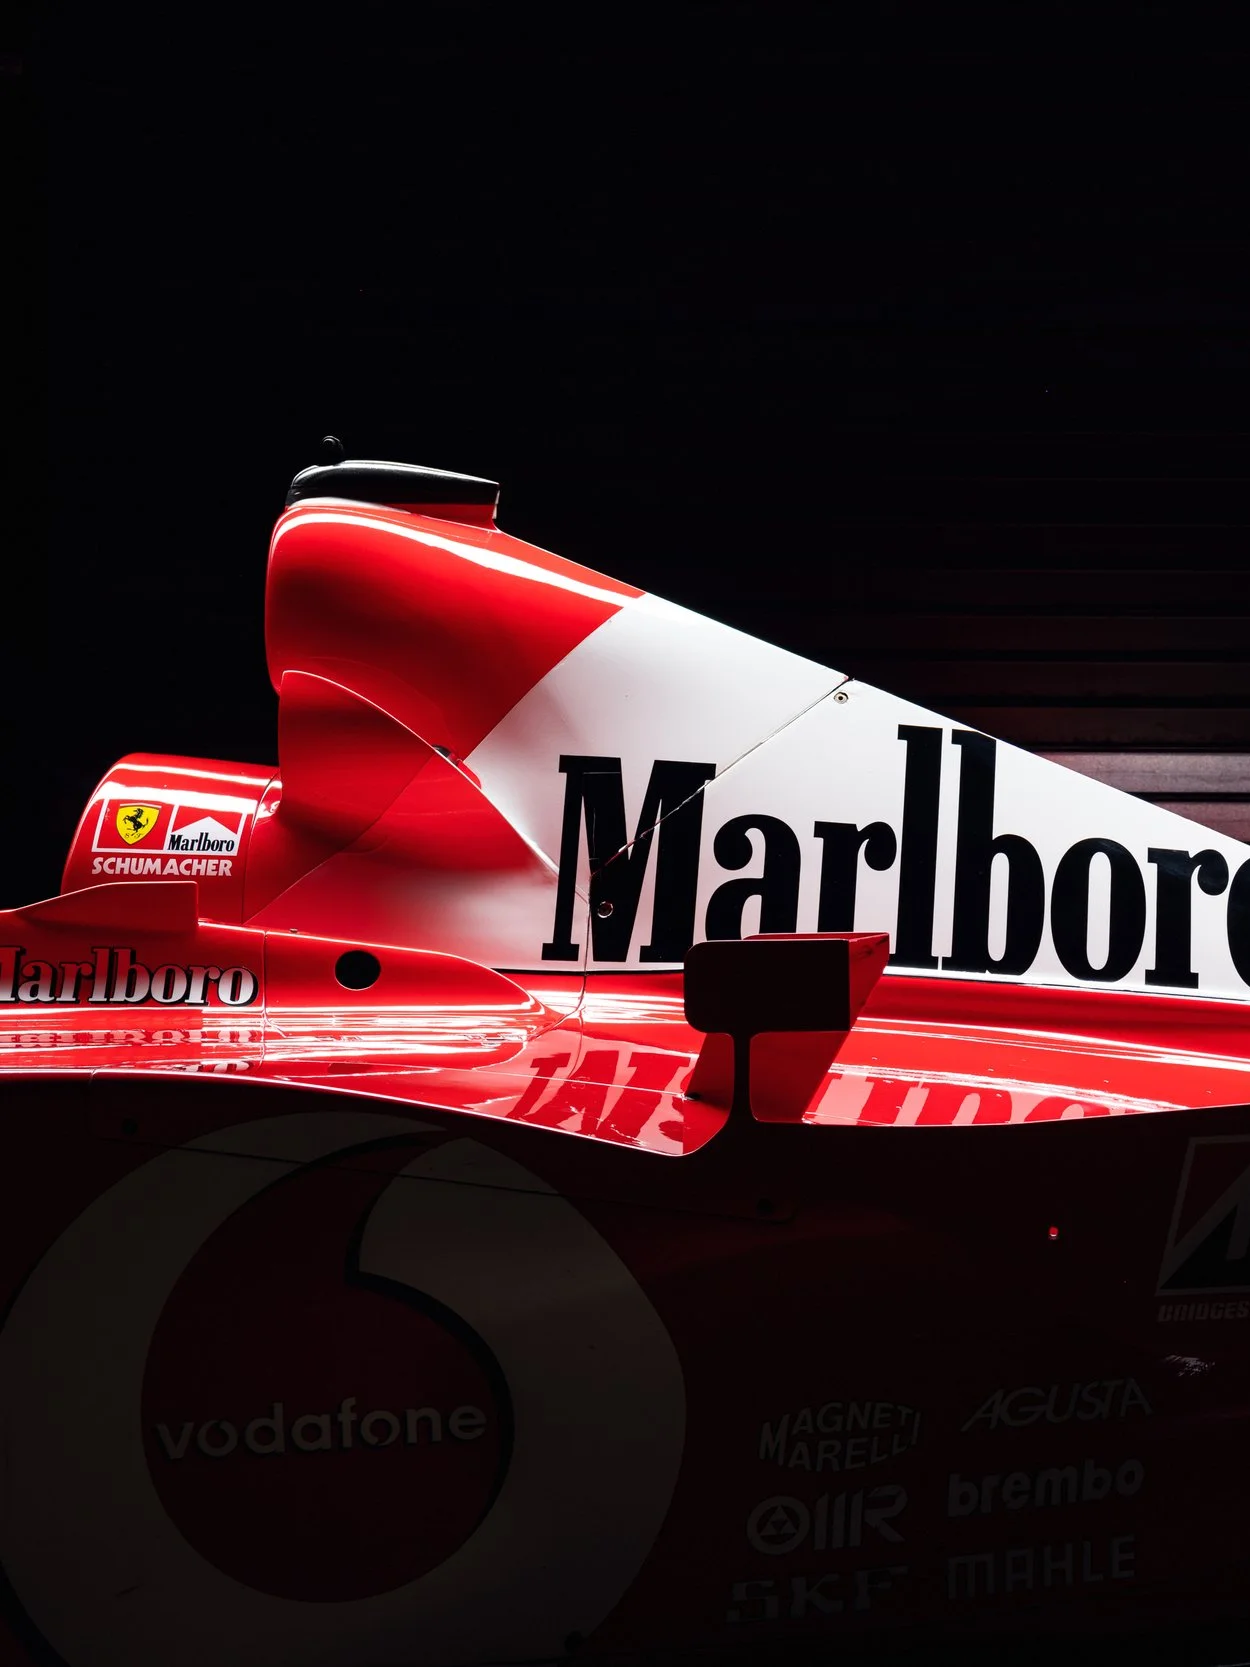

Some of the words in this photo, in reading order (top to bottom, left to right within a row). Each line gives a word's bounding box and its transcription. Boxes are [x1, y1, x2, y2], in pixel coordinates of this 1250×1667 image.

[91, 857, 233, 876] SCHUMACHER
[168, 832, 235, 852] Marlboro
[154, 1396, 488, 1460] vodafone
[758, 1401, 922, 1456] MAGNETI
[960, 1377, 1154, 1433] AGUSTA
[947, 1458, 1145, 1518] brembo
[724, 1565, 910, 1623] SKF
[947, 1534, 1137, 1600] MAHLE
